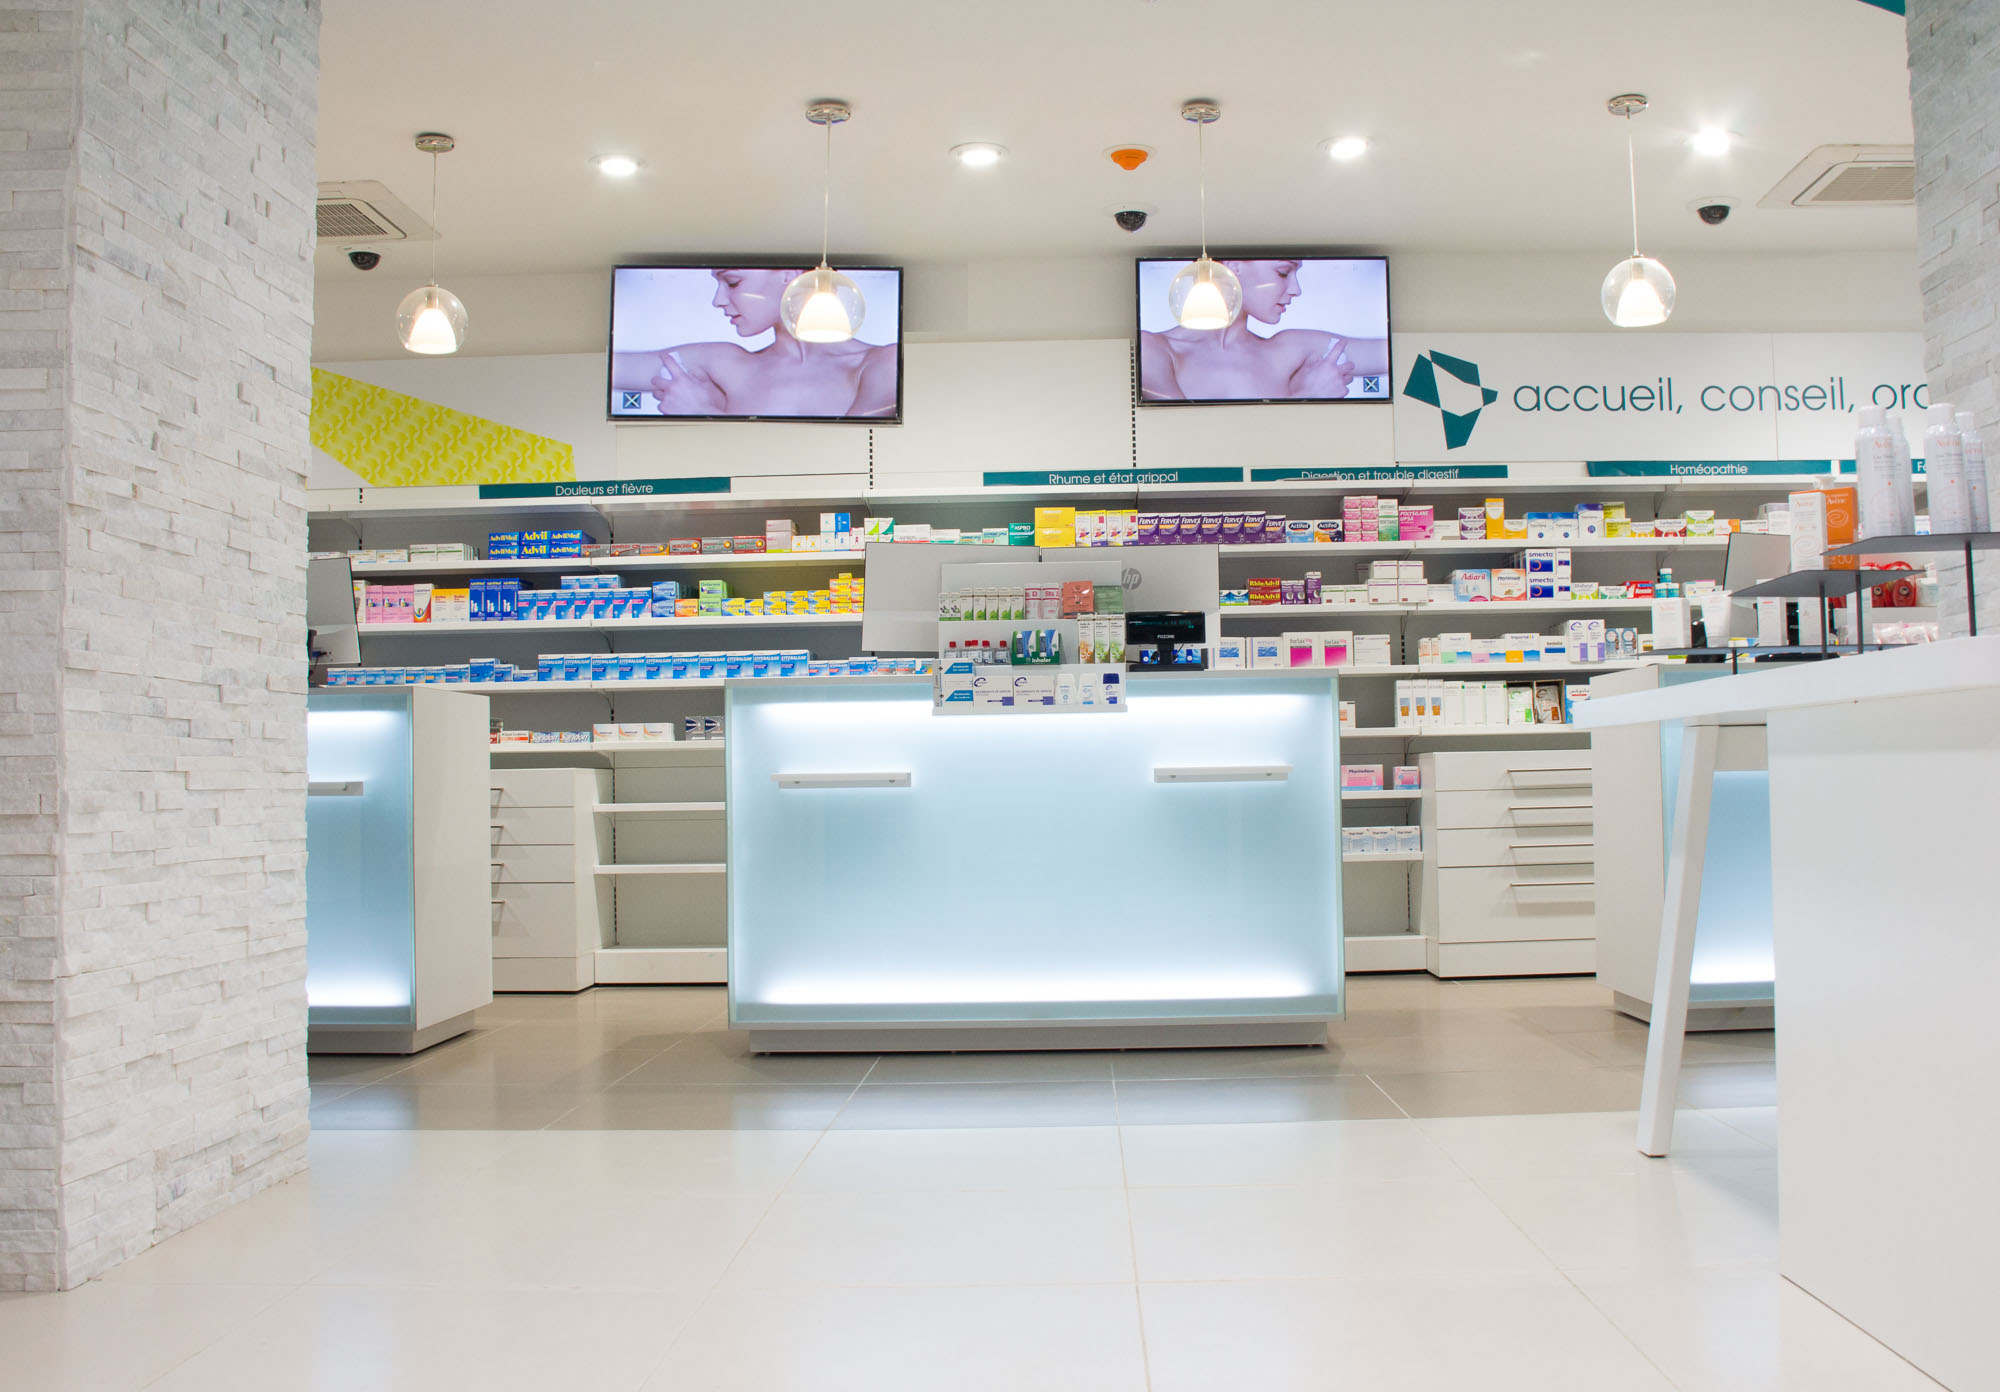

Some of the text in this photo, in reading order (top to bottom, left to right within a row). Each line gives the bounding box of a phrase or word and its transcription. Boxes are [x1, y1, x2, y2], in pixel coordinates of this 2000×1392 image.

[1513, 376, 1683, 415] accueil,
[1699, 376, 1855, 414] conseil,
[1357, 470, 1371, 480] et
[1373, 470, 1415, 480] trouble
[1417, 468, 1460, 480] digestif
[1670, 463, 1748, 476] Homéopathie
[1048, 471, 1179, 485] Rhume et état grippal
[555, 482, 654, 496] Douleurs et fièvre
[522, 531, 548, 541] Advil
[521, 545, 547, 555] Advil
[1122, 568, 1140, 590] hp
[1462, 573, 1486, 581] Adiaril
